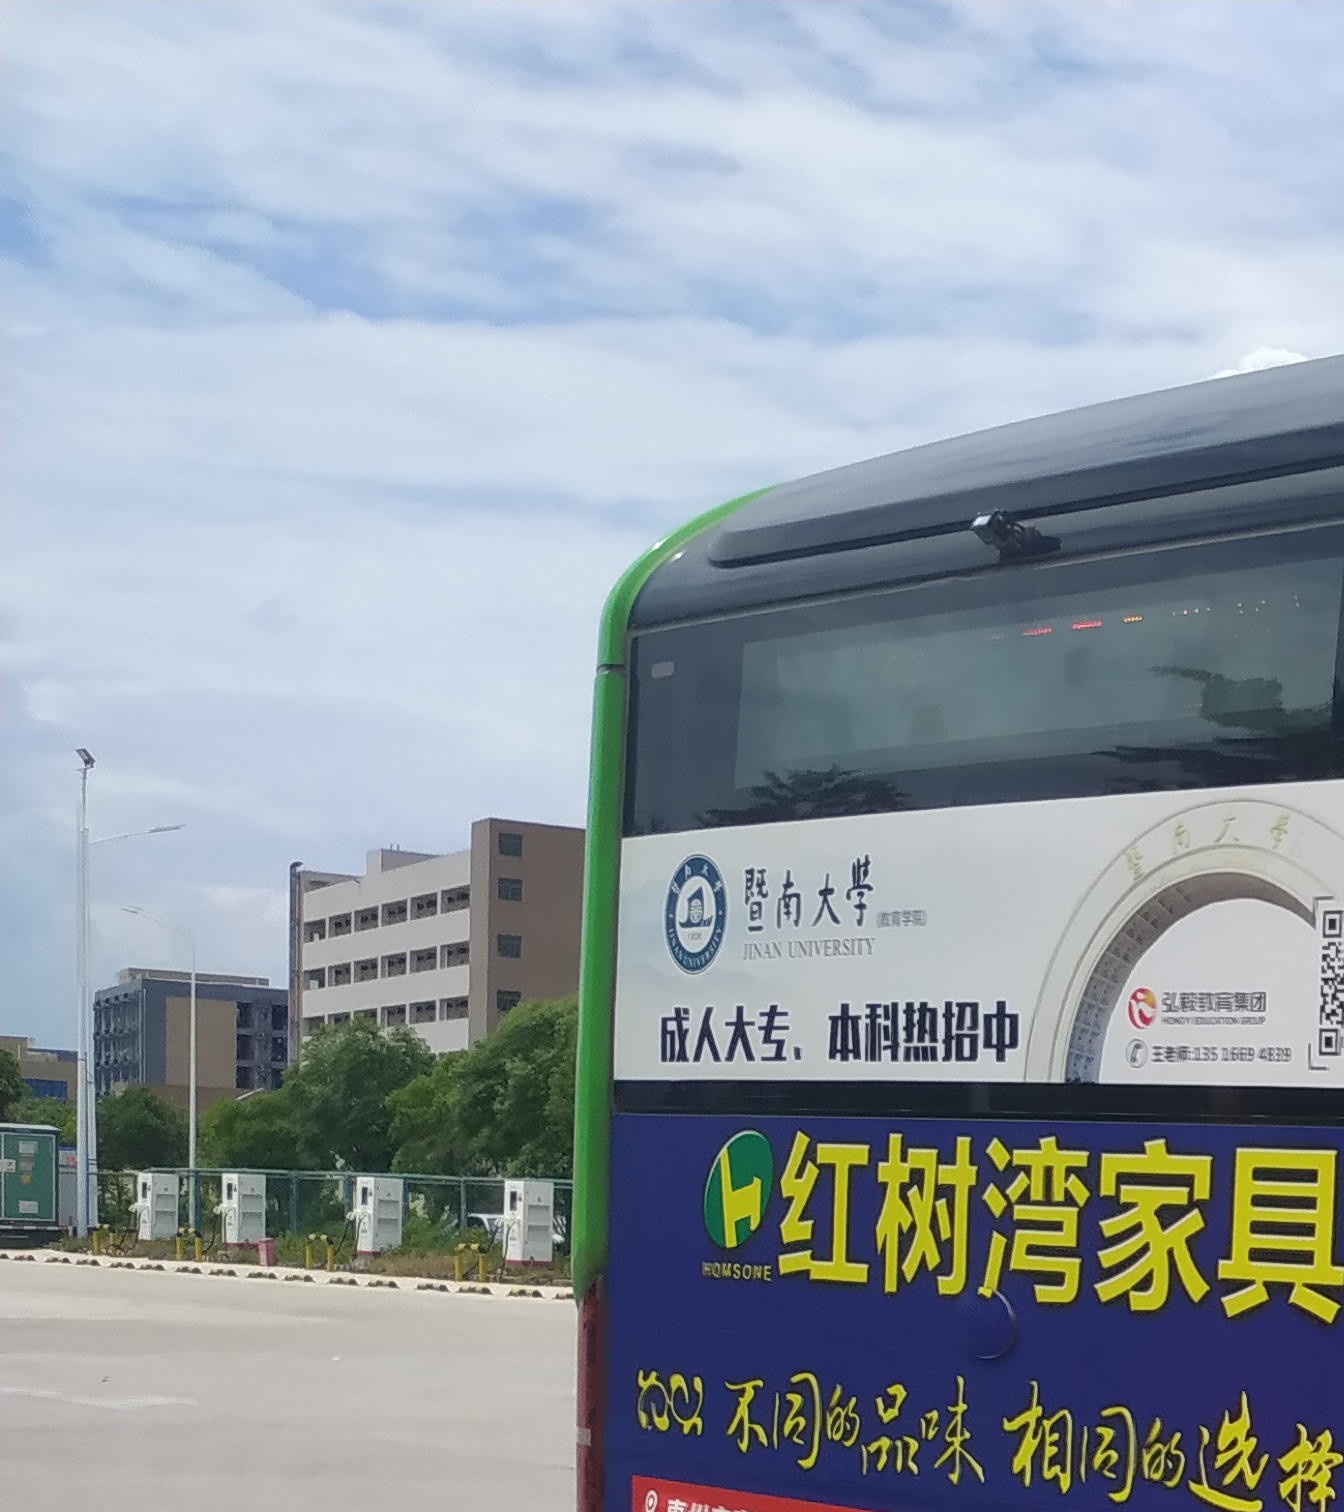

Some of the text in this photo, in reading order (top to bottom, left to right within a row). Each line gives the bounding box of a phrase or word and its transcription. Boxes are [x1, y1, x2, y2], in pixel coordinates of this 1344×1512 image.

[742, 937, 876, 961] JINAN UNIVERSITY
[702, 1261, 772, 1283] HOMSONE
[725, 1371, 987, 1486] 不同的品味
